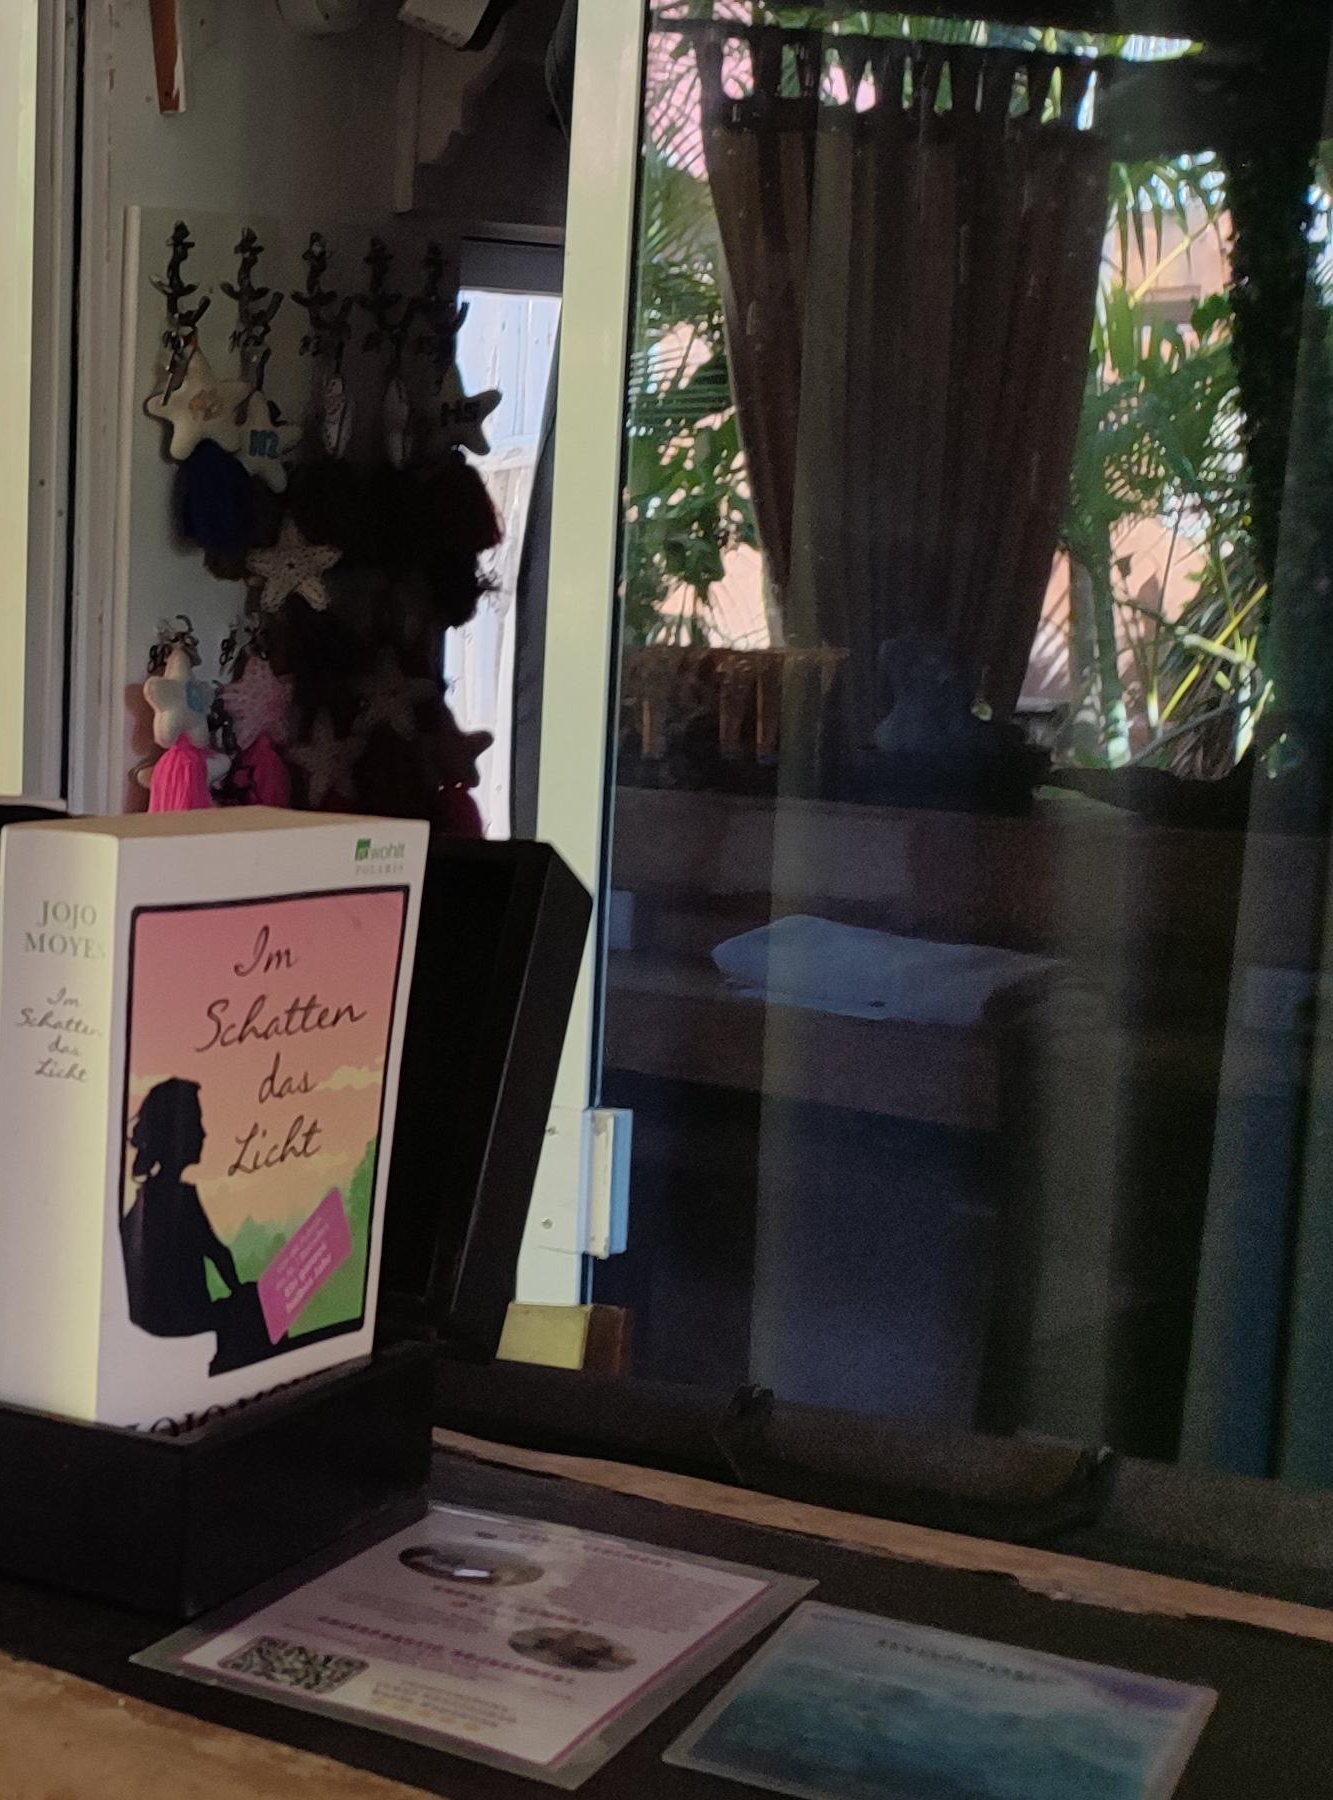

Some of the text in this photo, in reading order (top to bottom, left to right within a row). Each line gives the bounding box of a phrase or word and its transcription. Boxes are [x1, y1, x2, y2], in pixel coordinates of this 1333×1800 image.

[37, 900, 98, 931] JOJO
[234, 924, 300, 977] Im
[46, 987, 80, 1008] Im
[194, 993, 367, 1052] Schatten
[35, 1057, 88, 1083] Licht
[258, 1051, 317, 1104] das
[227, 1114, 323, 1177] Licht
